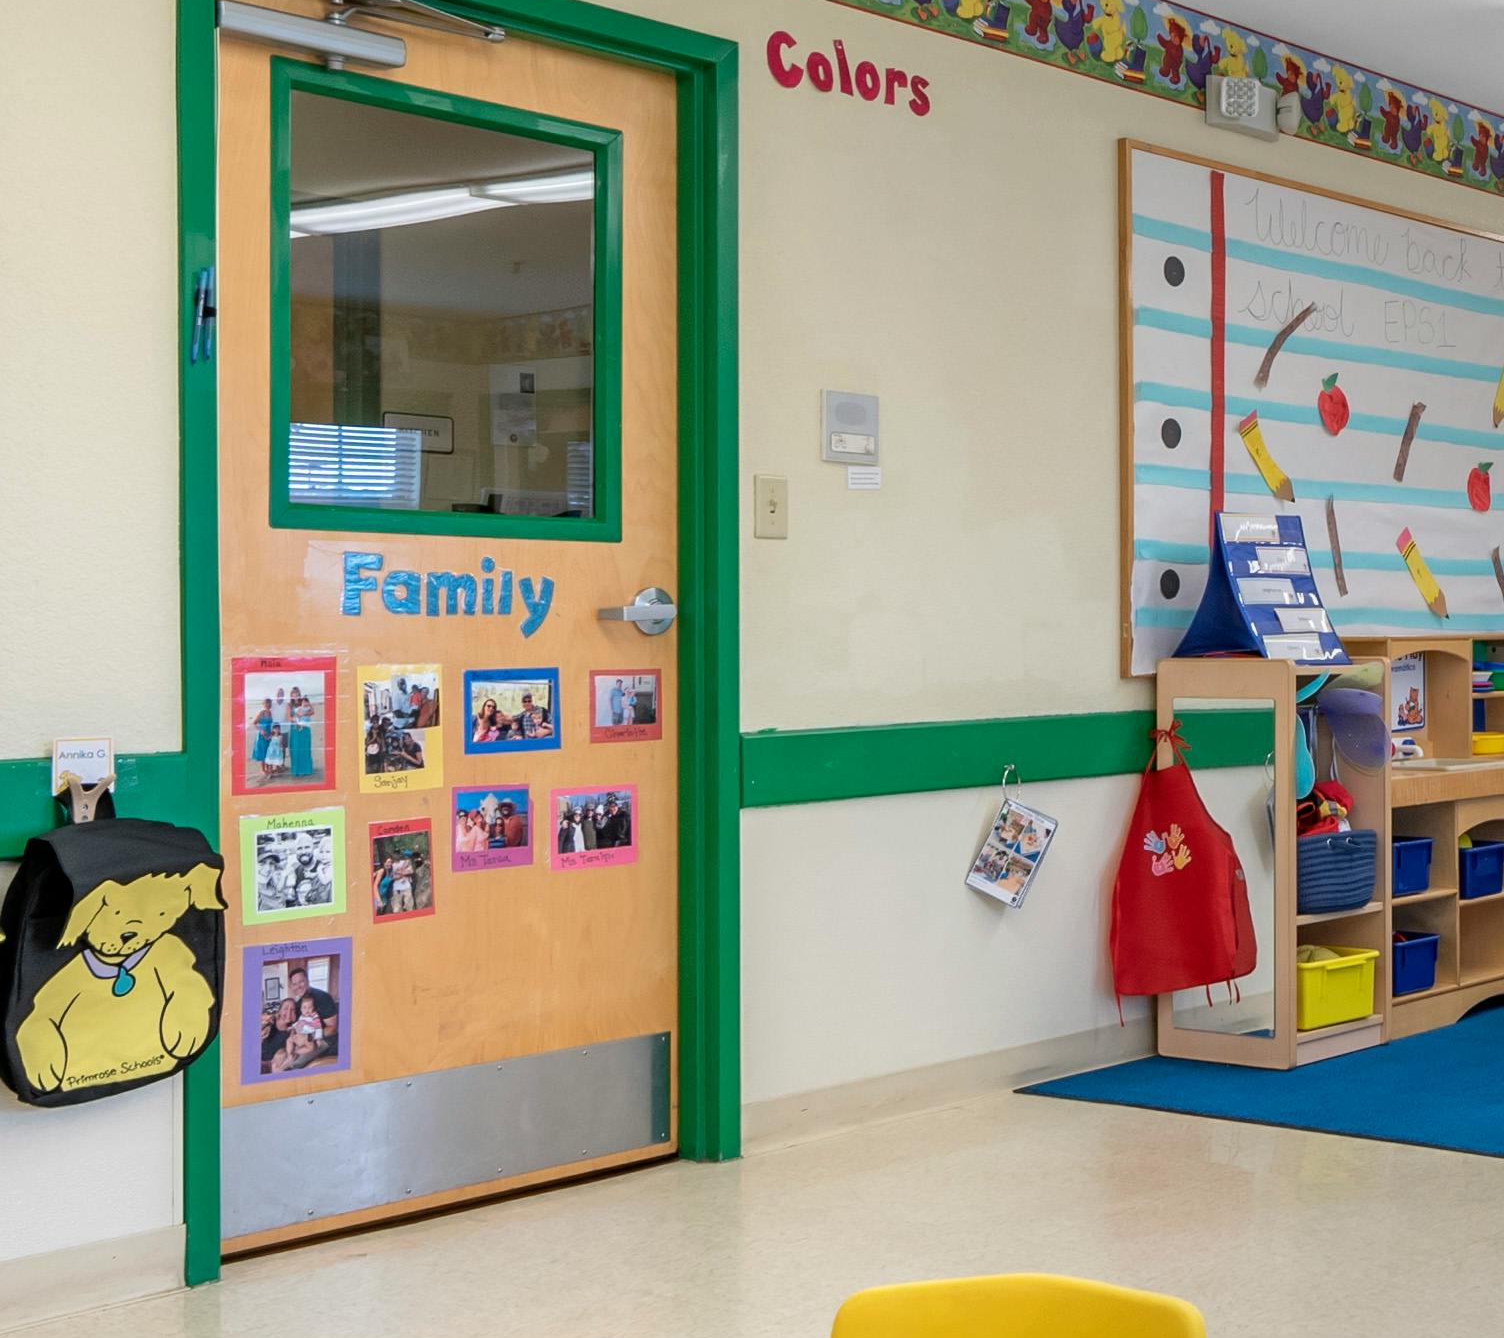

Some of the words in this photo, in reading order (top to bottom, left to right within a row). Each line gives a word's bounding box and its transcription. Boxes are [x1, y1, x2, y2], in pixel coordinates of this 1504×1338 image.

[766, 30, 931, 117] Colors
[1245, 188, 1391, 267] Welcome
[1400, 227, 1472, 283] back
[1384, 299, 1457, 348] EPS1
[341, 550, 555, 639] Family
[58, 749, 95, 761] Annika
[97, 750, 110, 760] G.
[373, 774, 409, 789] Sanjay
[66, 1072, 120, 1090] Primrose
